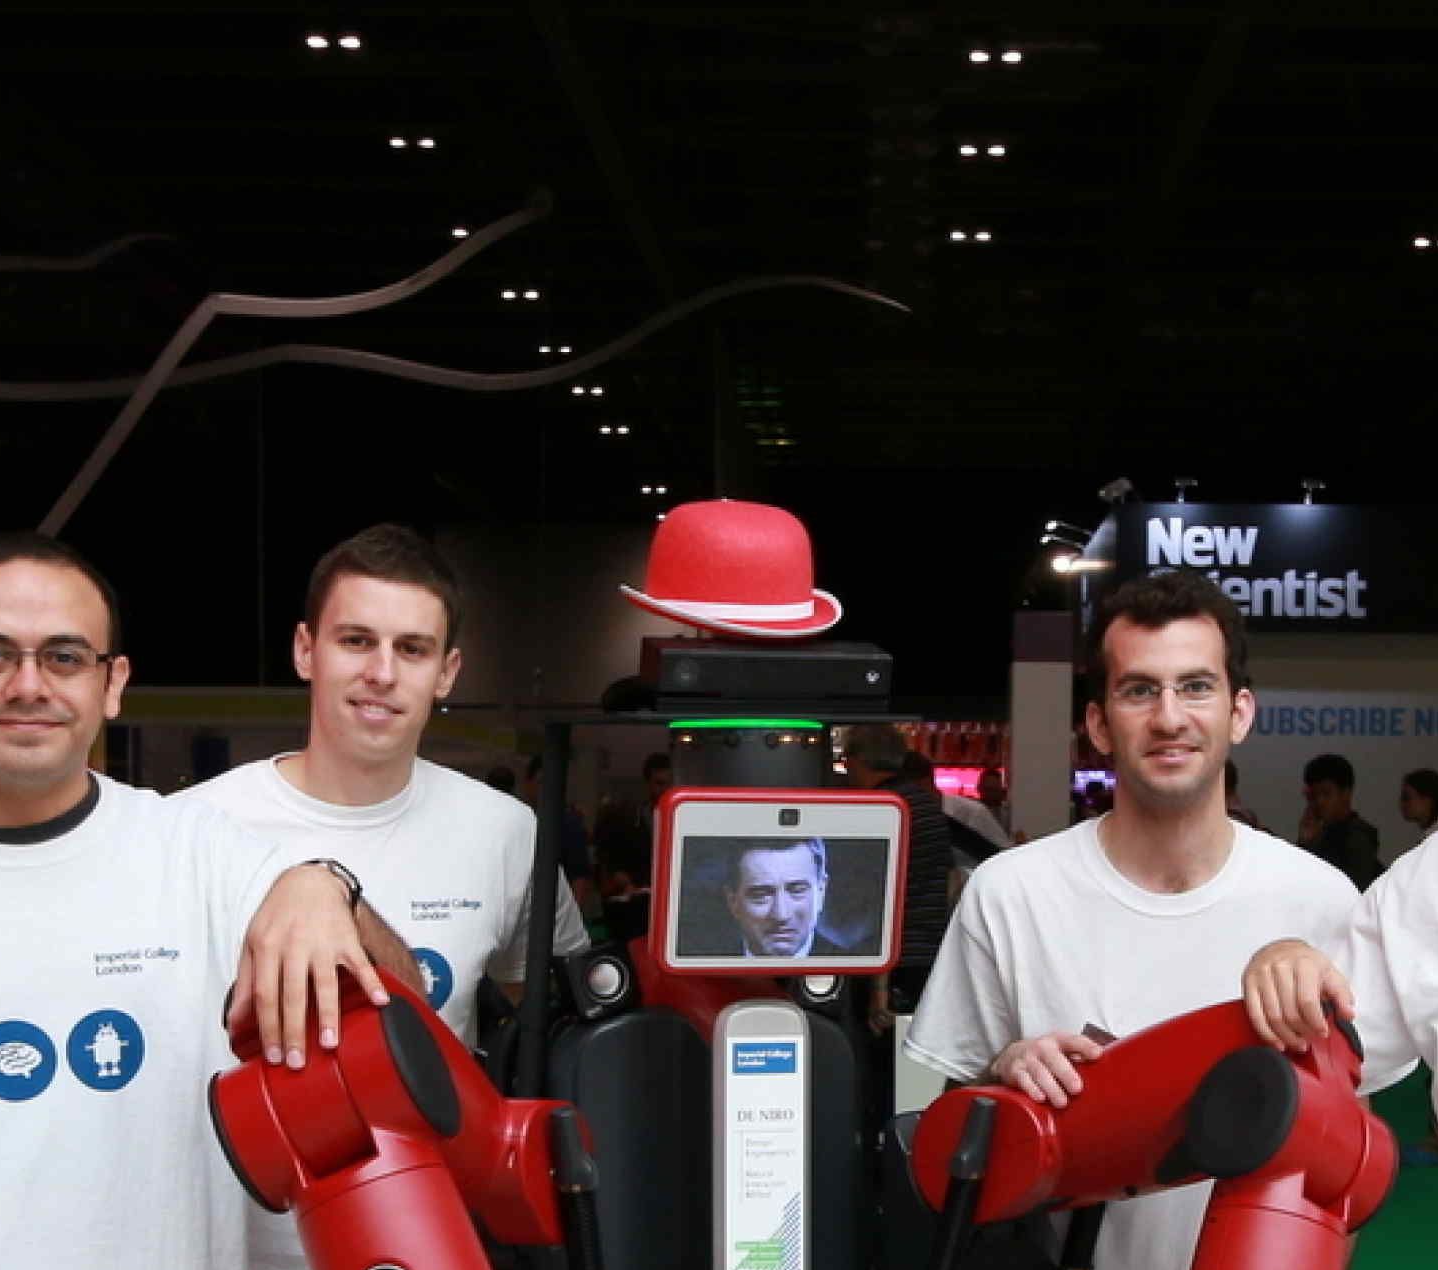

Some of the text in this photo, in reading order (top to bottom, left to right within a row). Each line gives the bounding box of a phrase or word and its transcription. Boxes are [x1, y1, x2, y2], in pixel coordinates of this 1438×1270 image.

[1147, 517, 1258, 567] New
[1257, 706, 1406, 737] UBSCRIBE
[95, 949, 141, 965] Imperial
[95, 963, 143, 976] London
